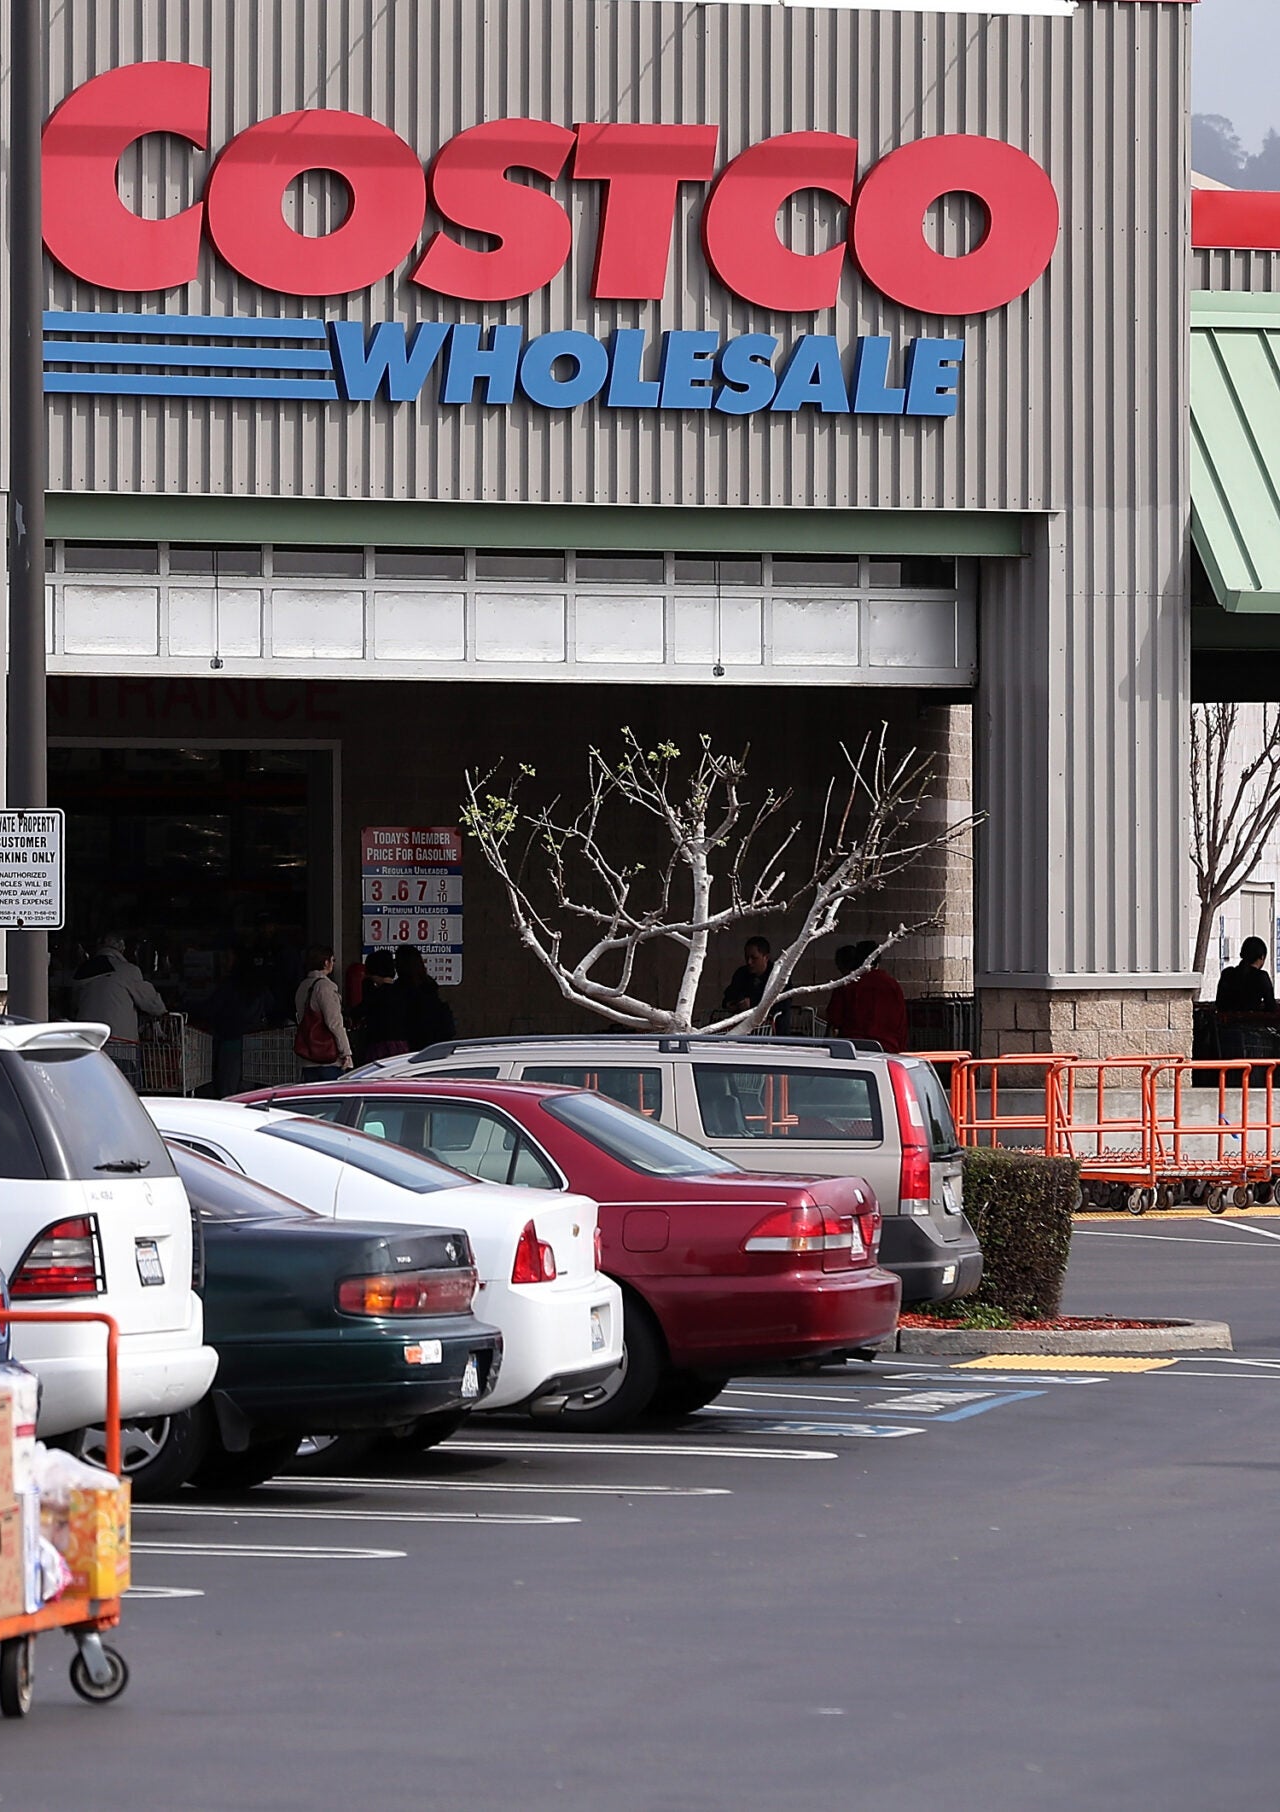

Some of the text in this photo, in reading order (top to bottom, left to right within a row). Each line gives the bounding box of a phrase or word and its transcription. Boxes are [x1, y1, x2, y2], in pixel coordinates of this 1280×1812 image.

[41, 61, 1060, 316] COSTCO
[329, 320, 965, 417] WHOLESALE
[19, 817, 56, 832] PROPERTY
[373, 831, 450, 845] TODAY'S MEMBER
[32, 852, 56, 863] ONLY
[366, 847, 457, 861] PRICE FOR GASOLINE
[382, 866, 448, 875] REGULAR UNLEADED
[382, 906, 448, 914] PREMIUM UNLEADED
